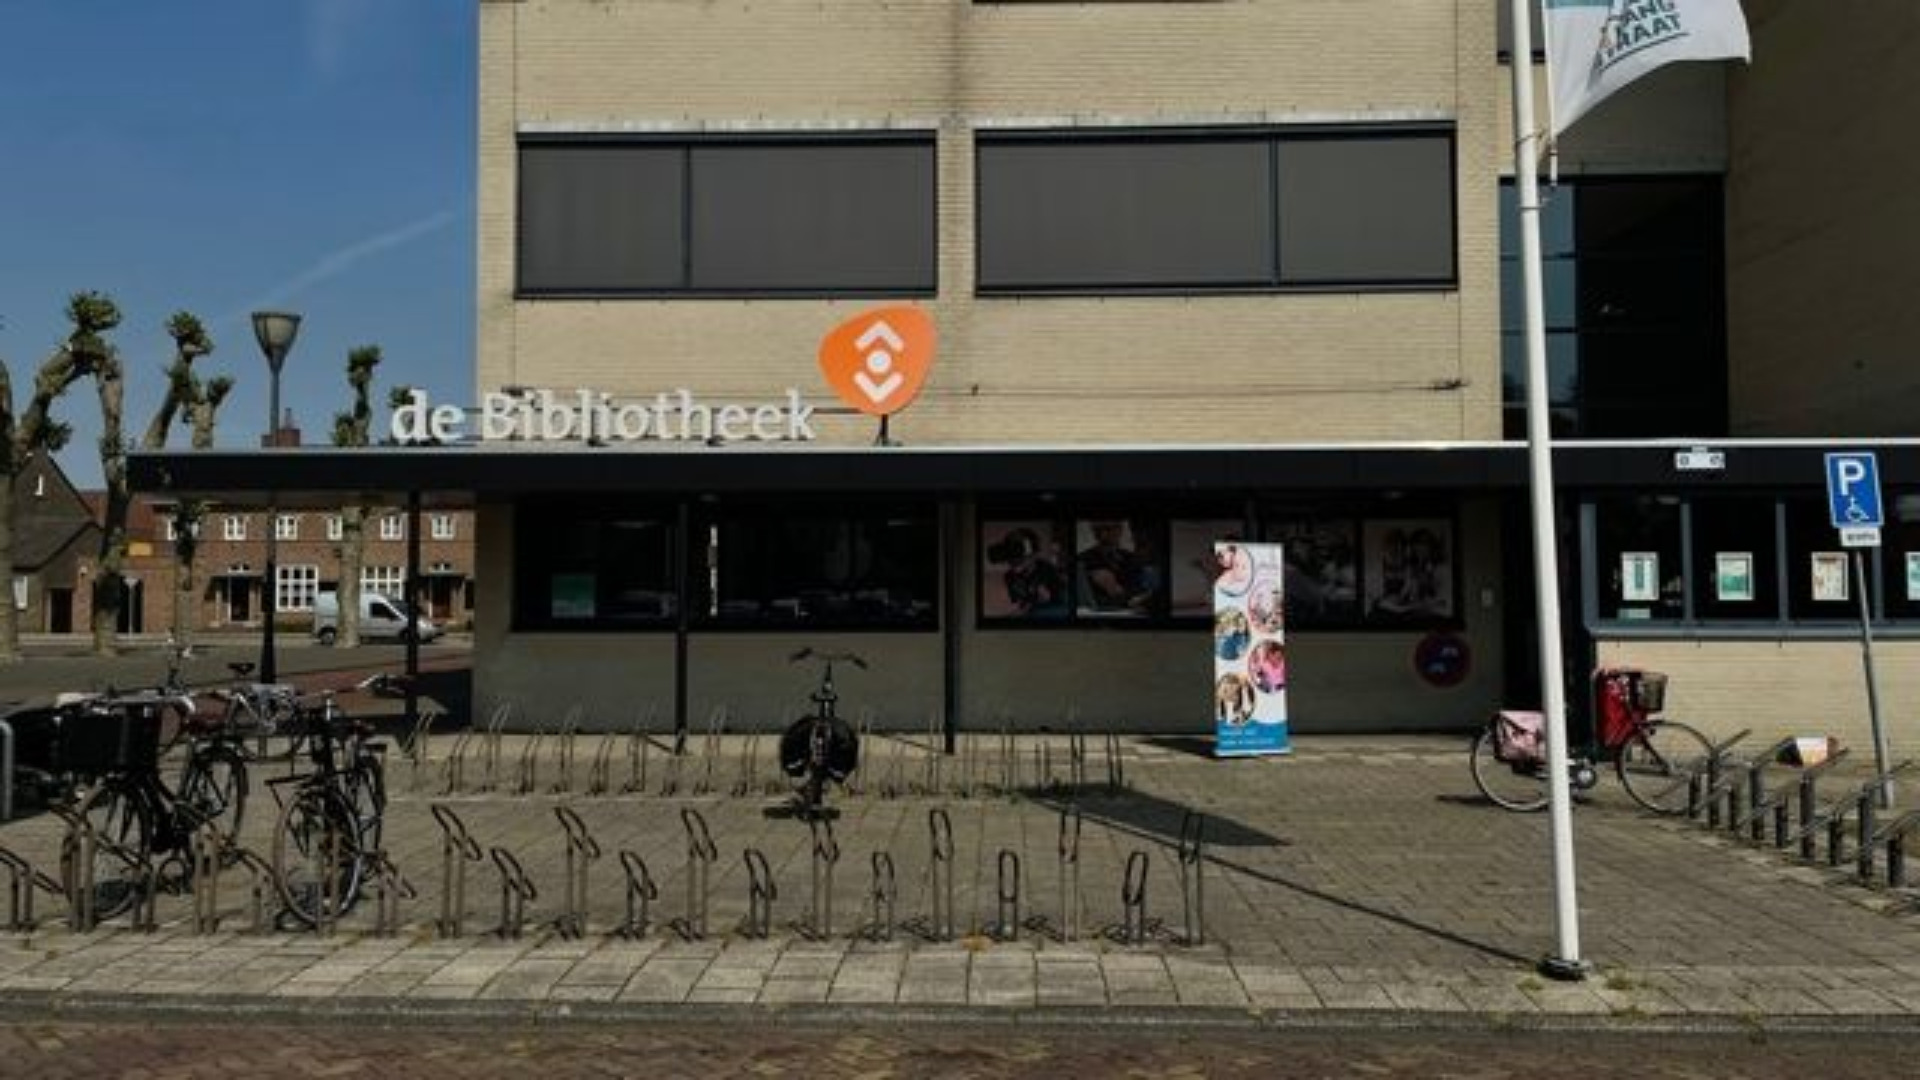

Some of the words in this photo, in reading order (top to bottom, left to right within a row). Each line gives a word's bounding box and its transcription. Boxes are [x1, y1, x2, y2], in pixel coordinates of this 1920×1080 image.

[391, 387, 466, 444] de
[482, 387, 816, 440] Bibliotheek
[1838, 460, 1865, 496] P
